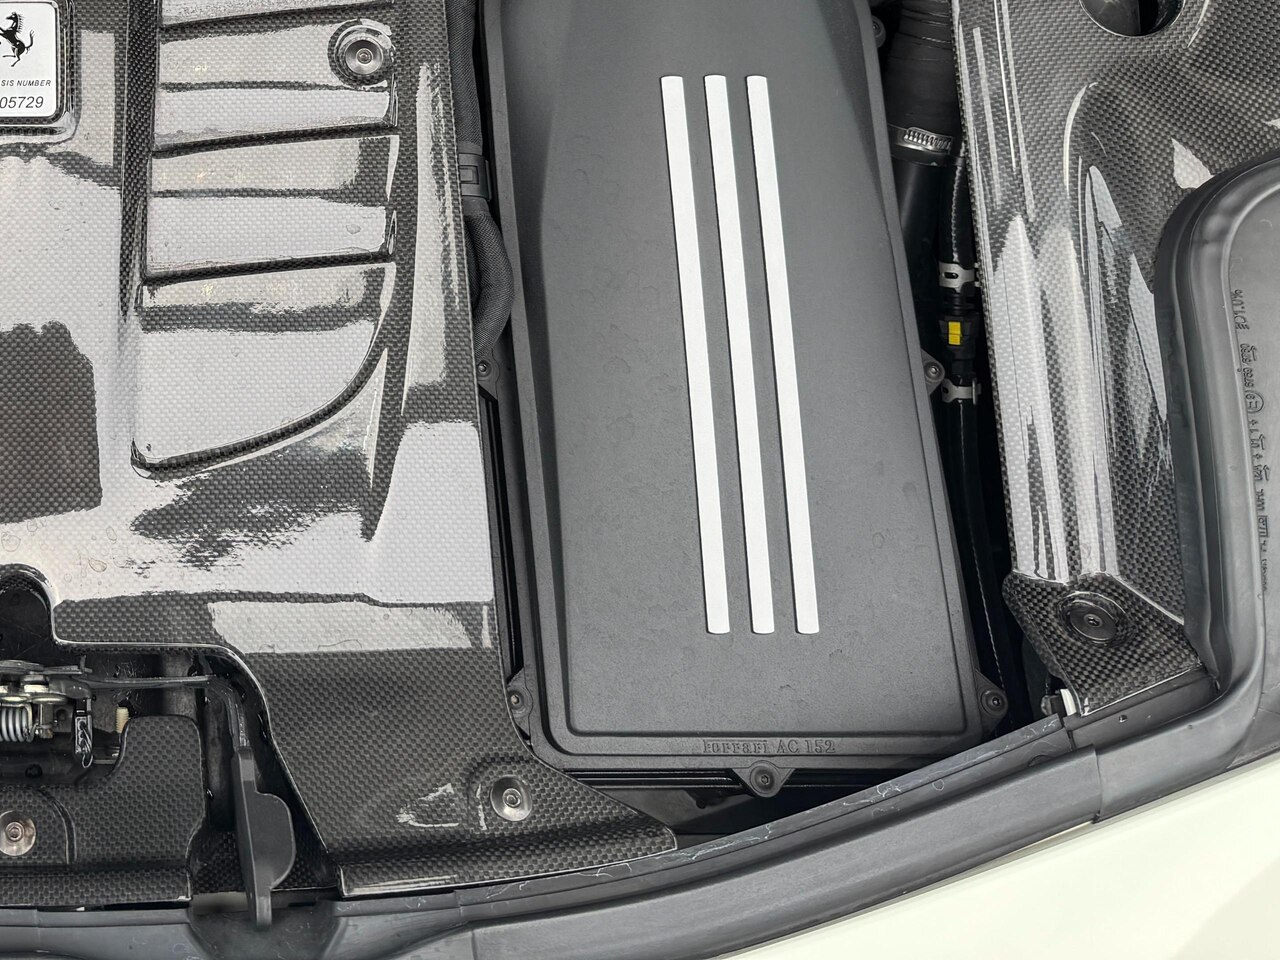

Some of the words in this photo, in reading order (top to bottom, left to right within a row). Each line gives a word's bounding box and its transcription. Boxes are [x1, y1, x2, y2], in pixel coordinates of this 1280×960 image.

[16, 79, 52, 87] NUMBER
[703, 739, 768, 753] Ferrari
[777, 739, 800, 753] AC
[806, 739, 836, 753] 152
